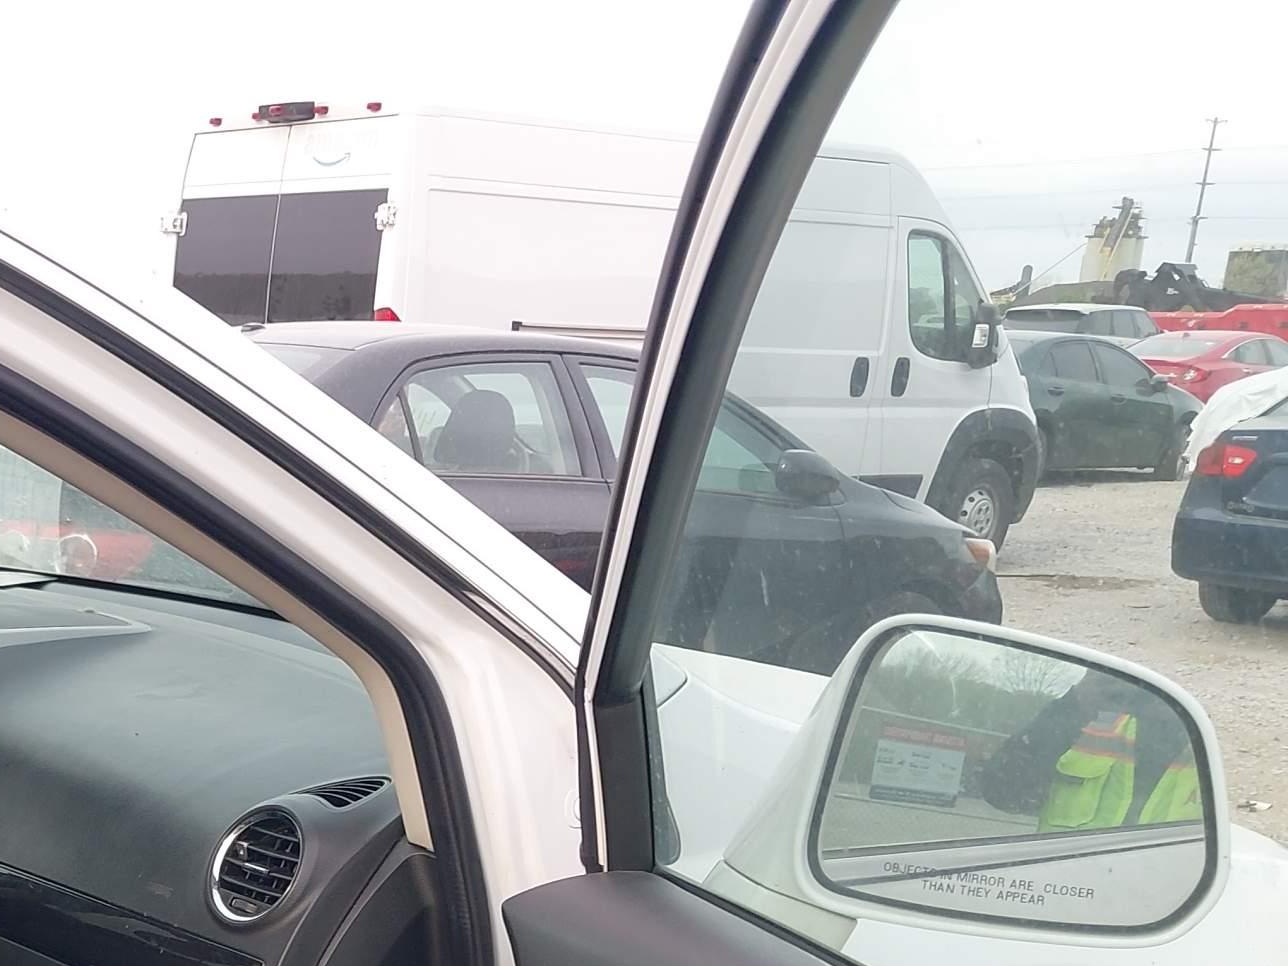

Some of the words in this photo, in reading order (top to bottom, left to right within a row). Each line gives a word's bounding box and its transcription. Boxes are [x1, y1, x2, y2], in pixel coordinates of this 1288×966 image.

[883, 861, 938, 877] OBJECTS
[939, 871, 953, 881] IN
[956, 872, 1005, 888] MIRROR
[1009, 879, 1034, 892] ARE
[1043, 883, 1095, 900] CLOSER
[922, 879, 955, 895] THAN
[960, 885, 992, 899] THEY
[996, 890, 1045, 906] APPEAR
